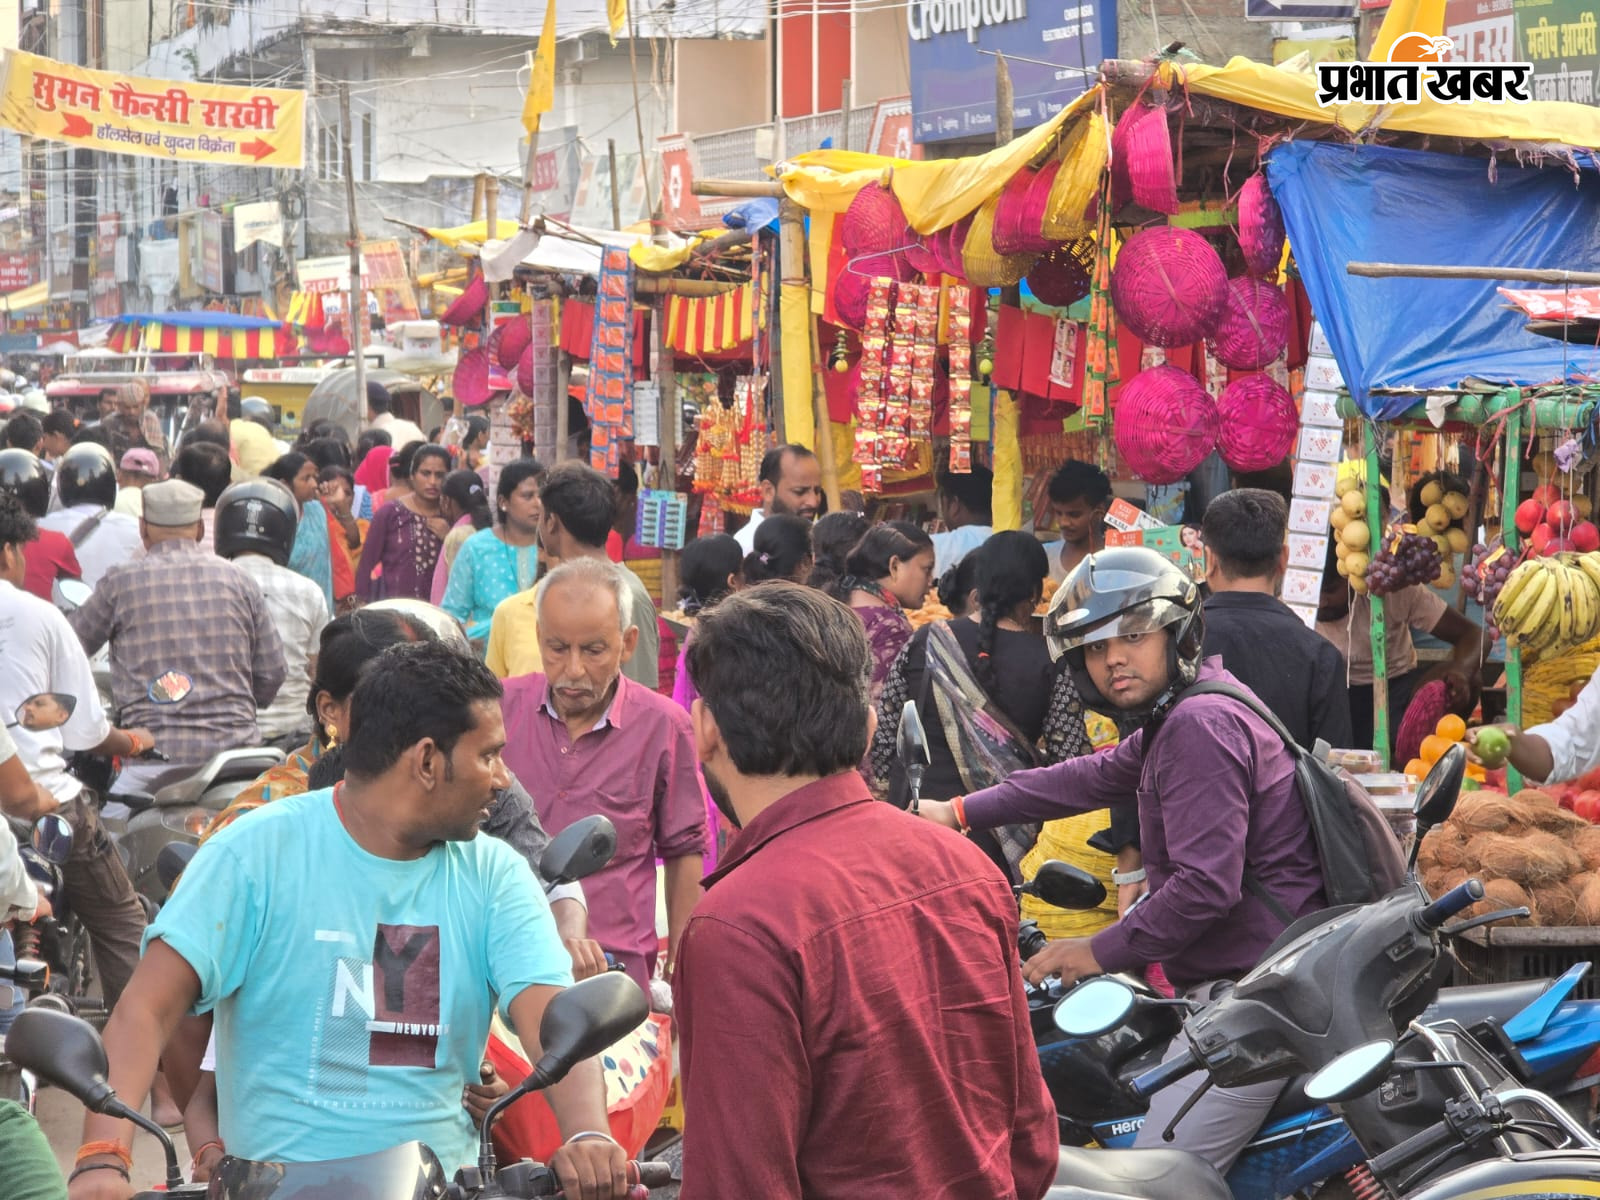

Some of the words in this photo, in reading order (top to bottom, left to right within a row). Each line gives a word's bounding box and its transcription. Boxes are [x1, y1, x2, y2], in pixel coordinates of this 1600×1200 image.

[33, 71, 102, 112] सुमन
[109, 82, 194, 124] फैन्सी
[200, 96, 280, 129] राखी
[97, 123, 141, 144] हॉलसेल
[144, 130, 161, 146] एवं
[164, 135, 195, 155] खुदरा
[198, 133, 236, 153] विक्रेता
[1112, 1119, 1145, 1135] Hero
